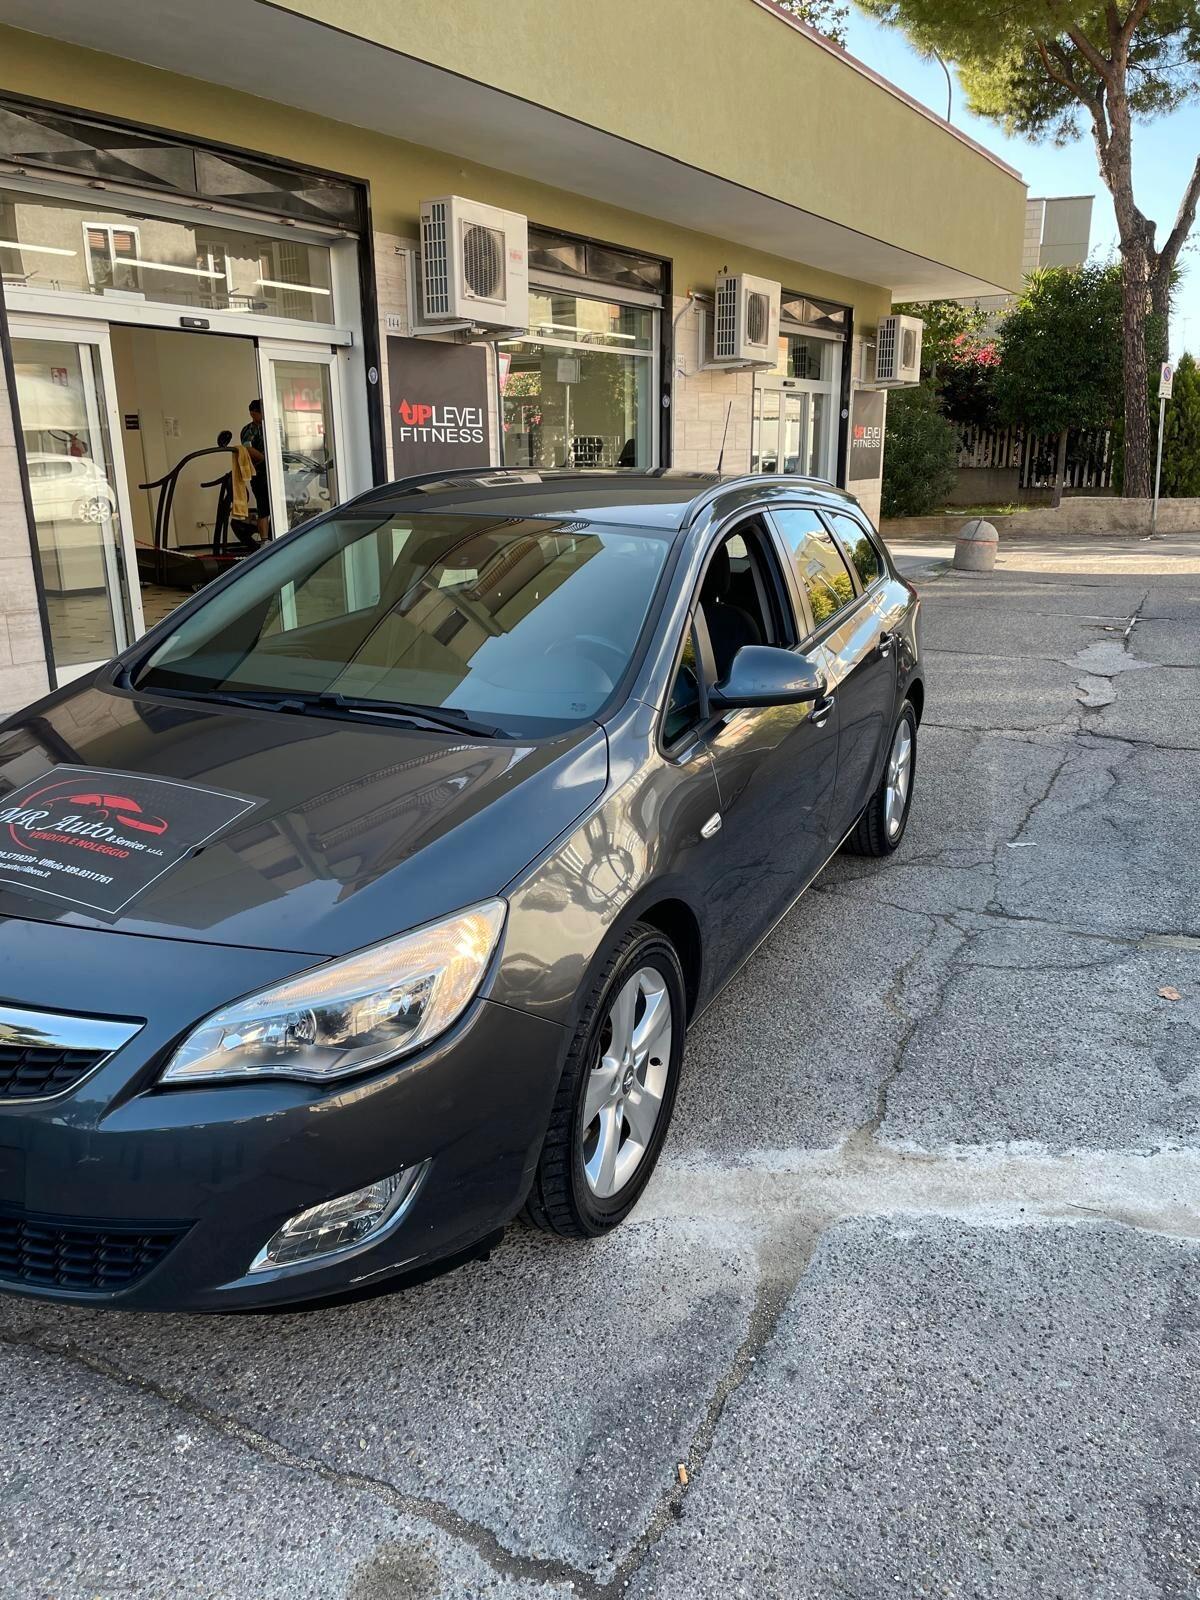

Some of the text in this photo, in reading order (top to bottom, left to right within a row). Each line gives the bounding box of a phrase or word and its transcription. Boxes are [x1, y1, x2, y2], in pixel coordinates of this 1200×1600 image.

[400, 427, 484, 443] FITNESS
[853, 439, 880, 448] FITNESS
[36, 815, 114, 838] Auto
[112, 836, 147, 851] Services
[28, 831, 67, 843] VENDITA
[74, 840, 130, 859] NOLEGGIO
[38, 858, 64, 870] Ufficio
